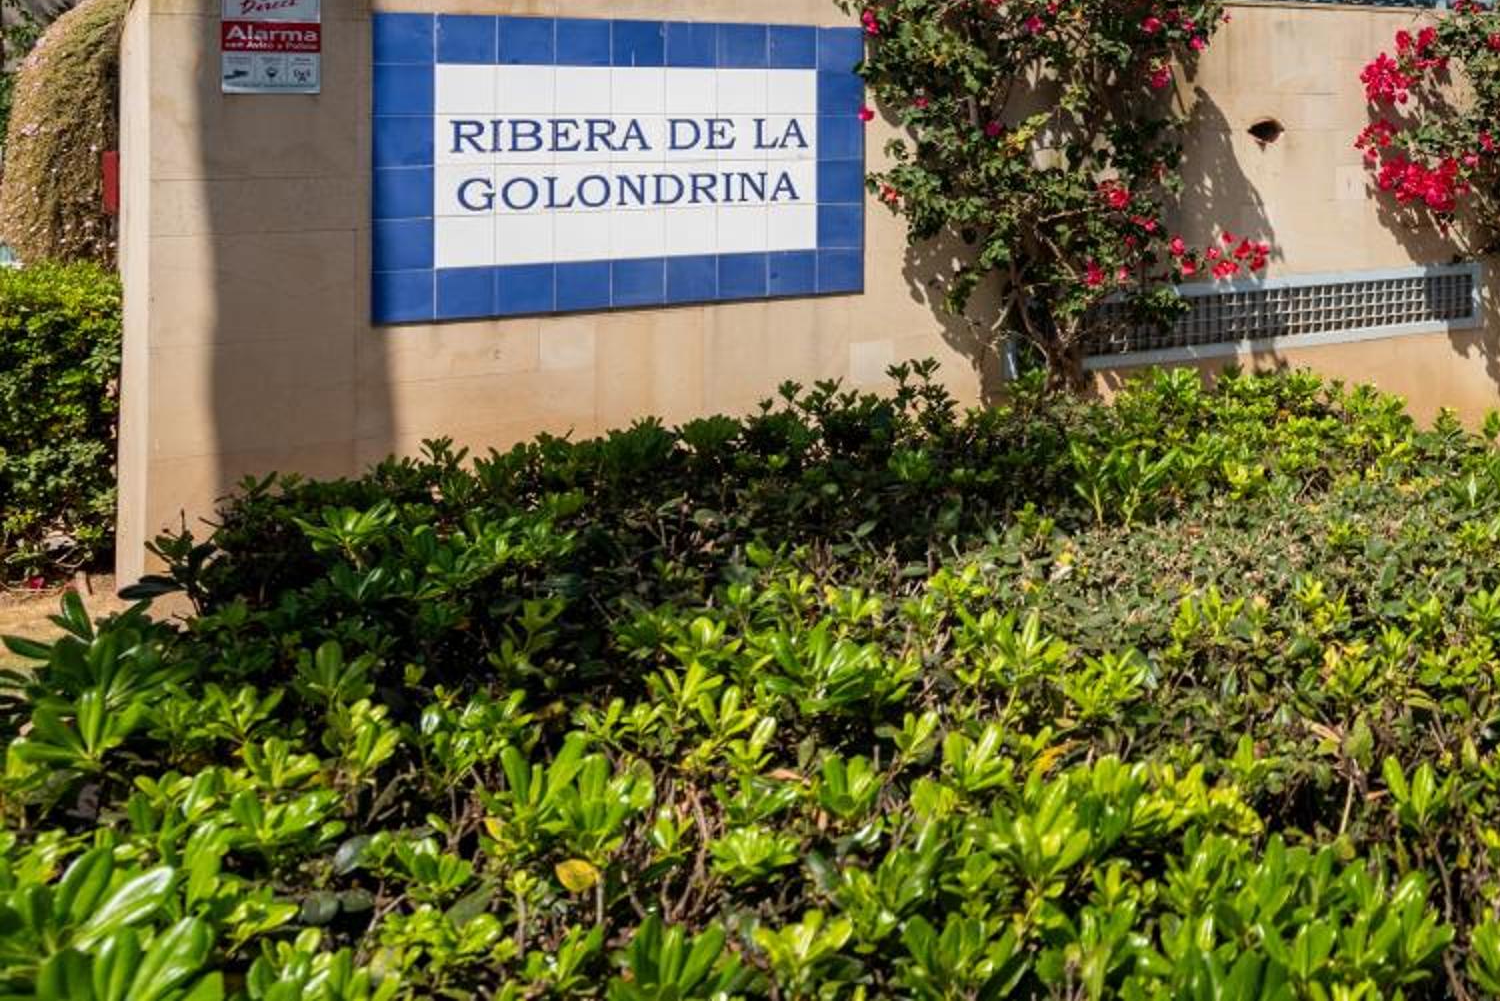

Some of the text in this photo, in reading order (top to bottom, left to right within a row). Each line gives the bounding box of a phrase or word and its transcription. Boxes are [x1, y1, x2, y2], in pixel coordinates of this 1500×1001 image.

[226, 24, 318, 41] Alarma
[449, 118, 809, 152] RIBERA DE LA
[457, 171, 800, 211] GOLONDRINA
